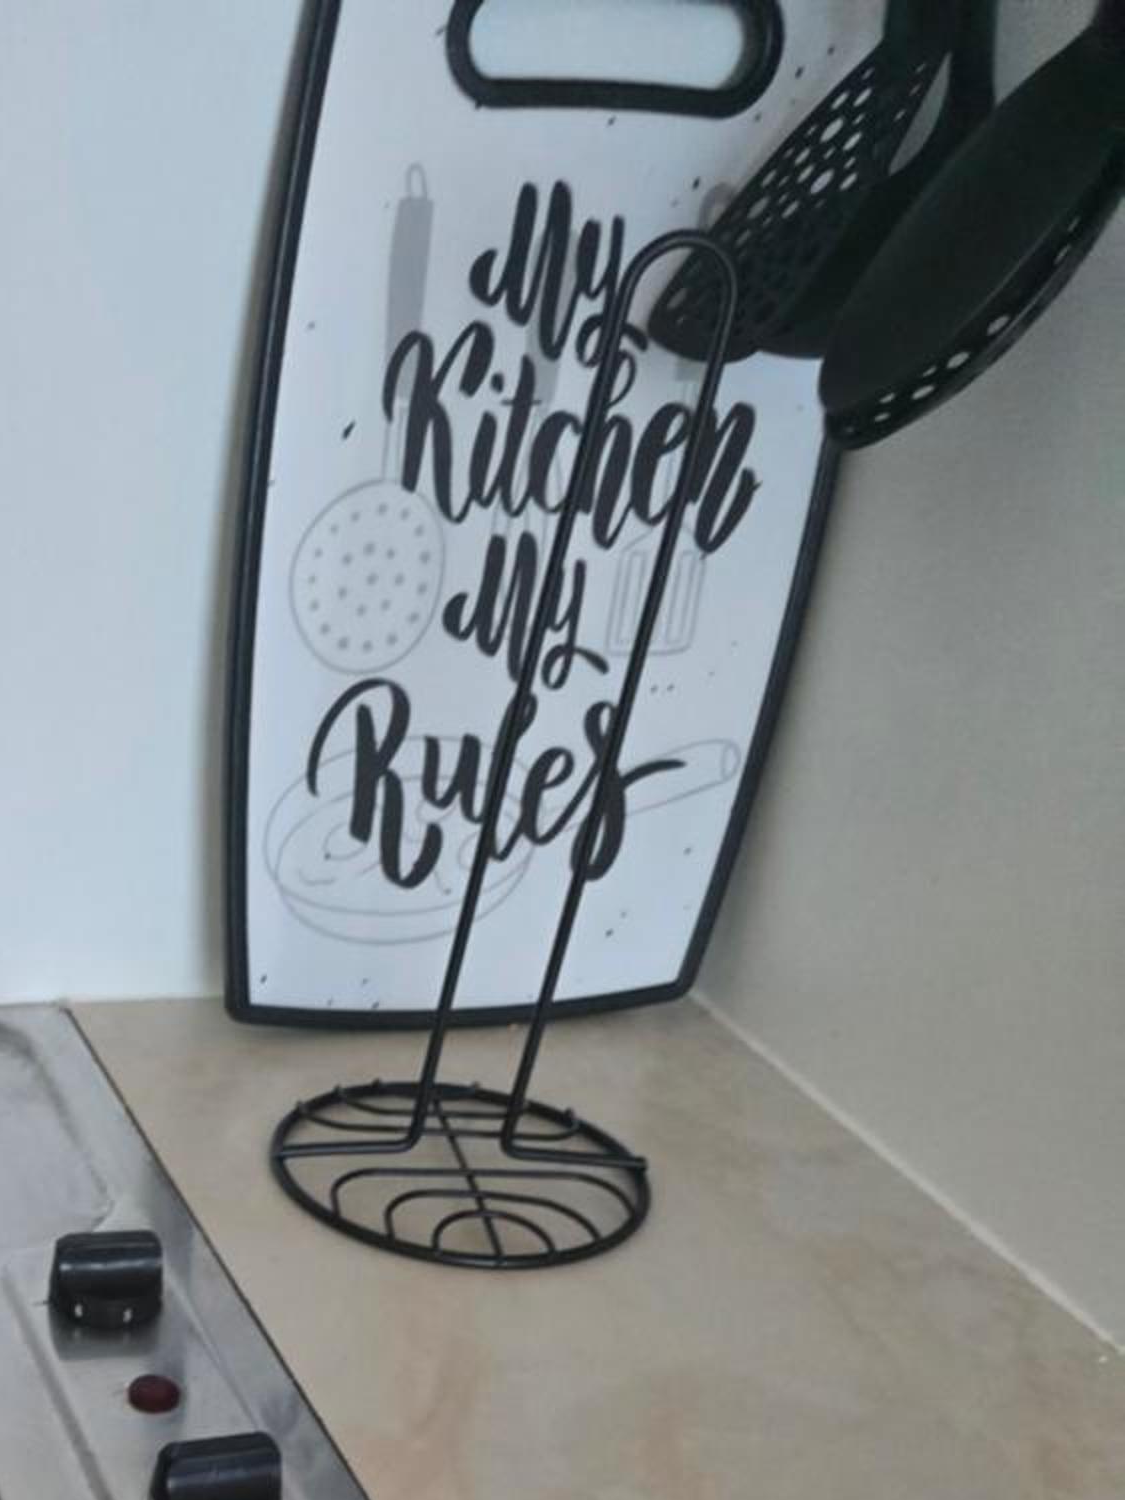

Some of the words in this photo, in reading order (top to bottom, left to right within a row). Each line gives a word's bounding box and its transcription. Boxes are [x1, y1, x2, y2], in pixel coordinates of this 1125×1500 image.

[469, 180, 648, 367] My
[383, 321, 760, 555] Kitchen
[443, 532, 609, 690] My
